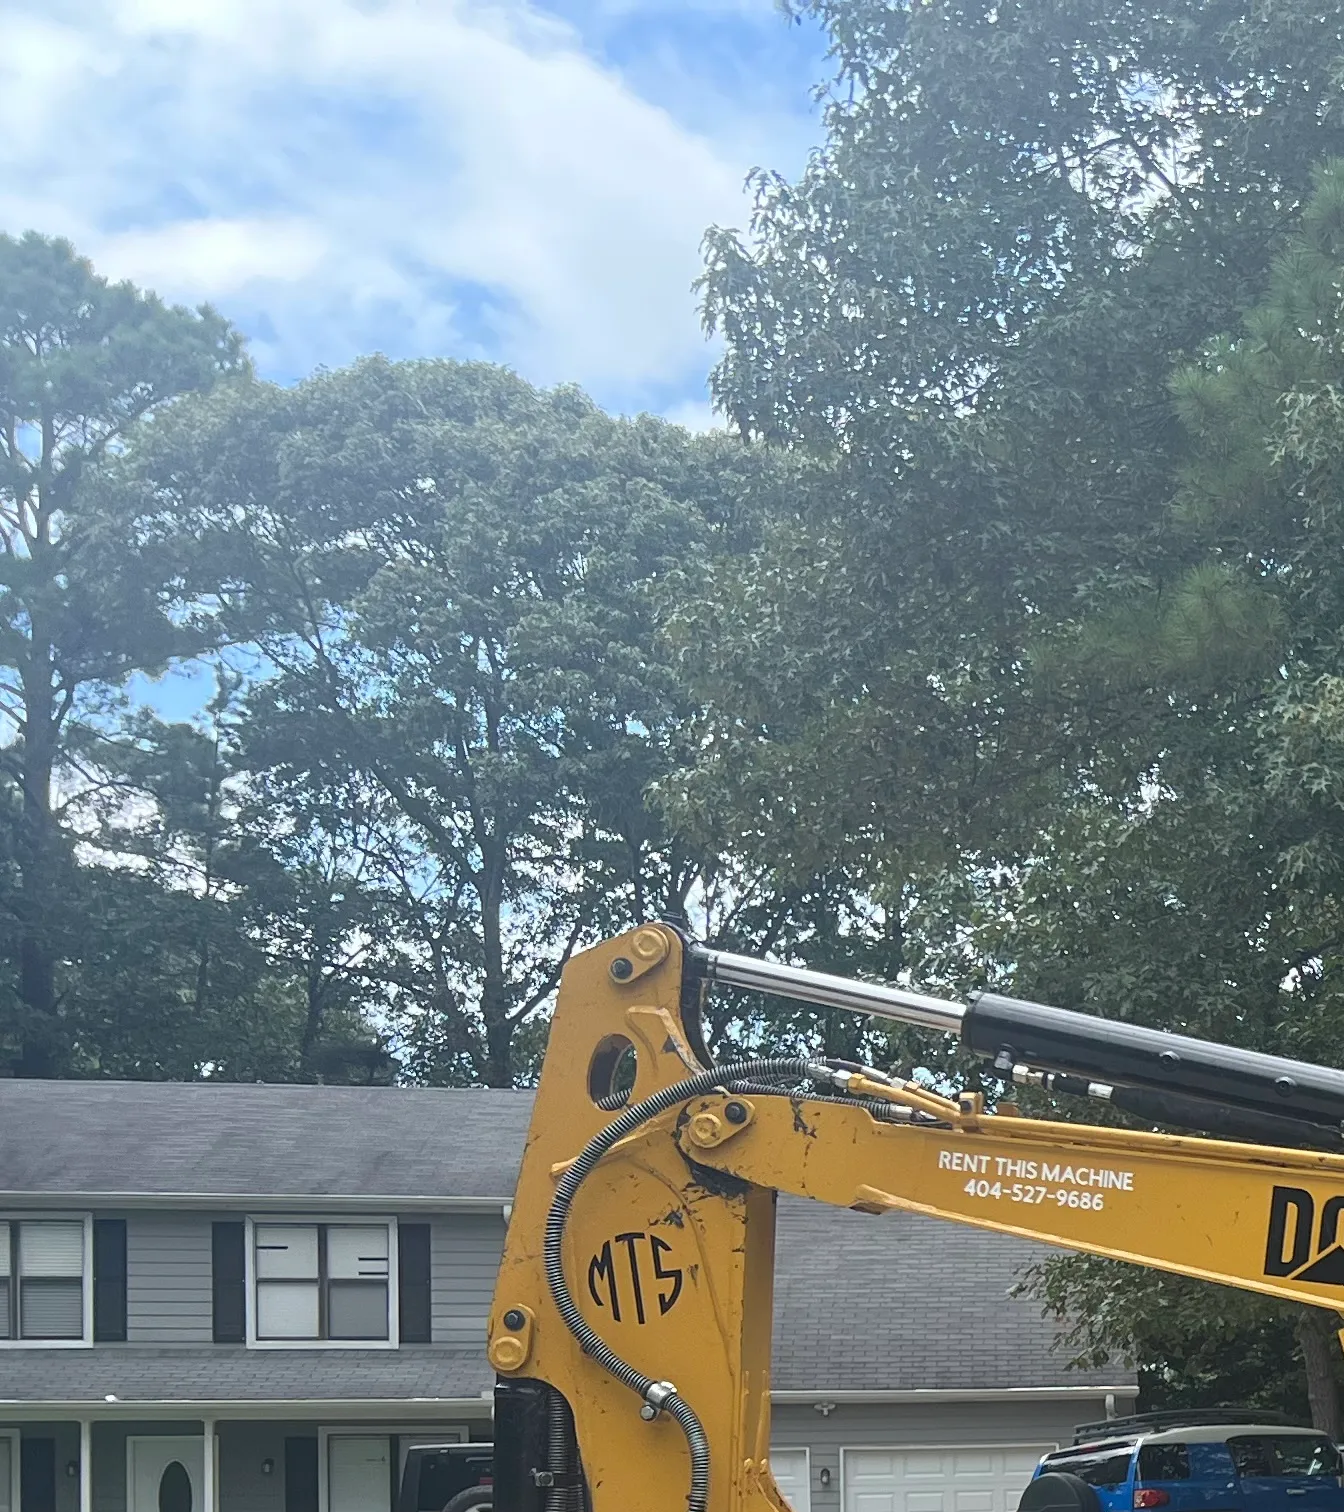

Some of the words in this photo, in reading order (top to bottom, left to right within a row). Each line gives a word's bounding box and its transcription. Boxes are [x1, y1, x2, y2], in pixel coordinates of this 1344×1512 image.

[937, 1150, 991, 1175] RENT
[995, 1156, 1038, 1180] THIS
[1041, 1162, 1135, 1191] MACHINE
[963, 1178, 1104, 1211] 404-527-9686
[588, 1231, 683, 1325] MTS
